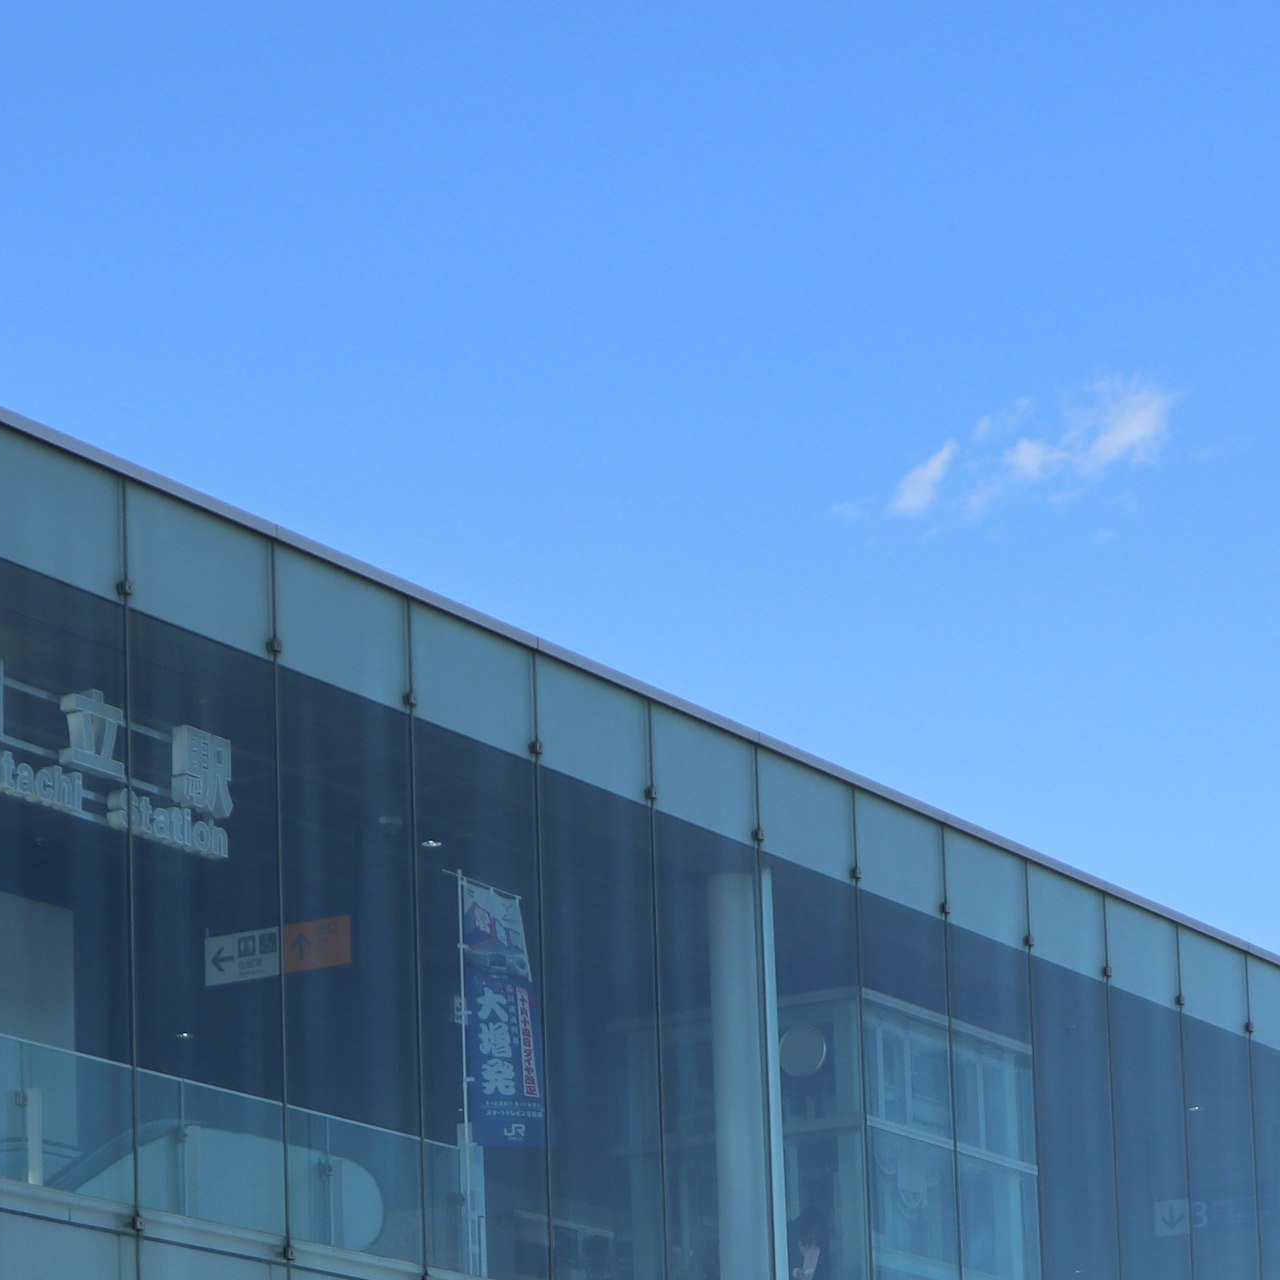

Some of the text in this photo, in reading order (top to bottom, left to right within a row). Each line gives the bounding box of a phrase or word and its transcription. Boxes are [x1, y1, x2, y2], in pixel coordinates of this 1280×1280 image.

[106, 788, 230, 859] Station
[476, 985, 516, 1096] 大増発
[504, 1123, 527, 1137] JR
[1191, 1200, 1209, 1229] 3
